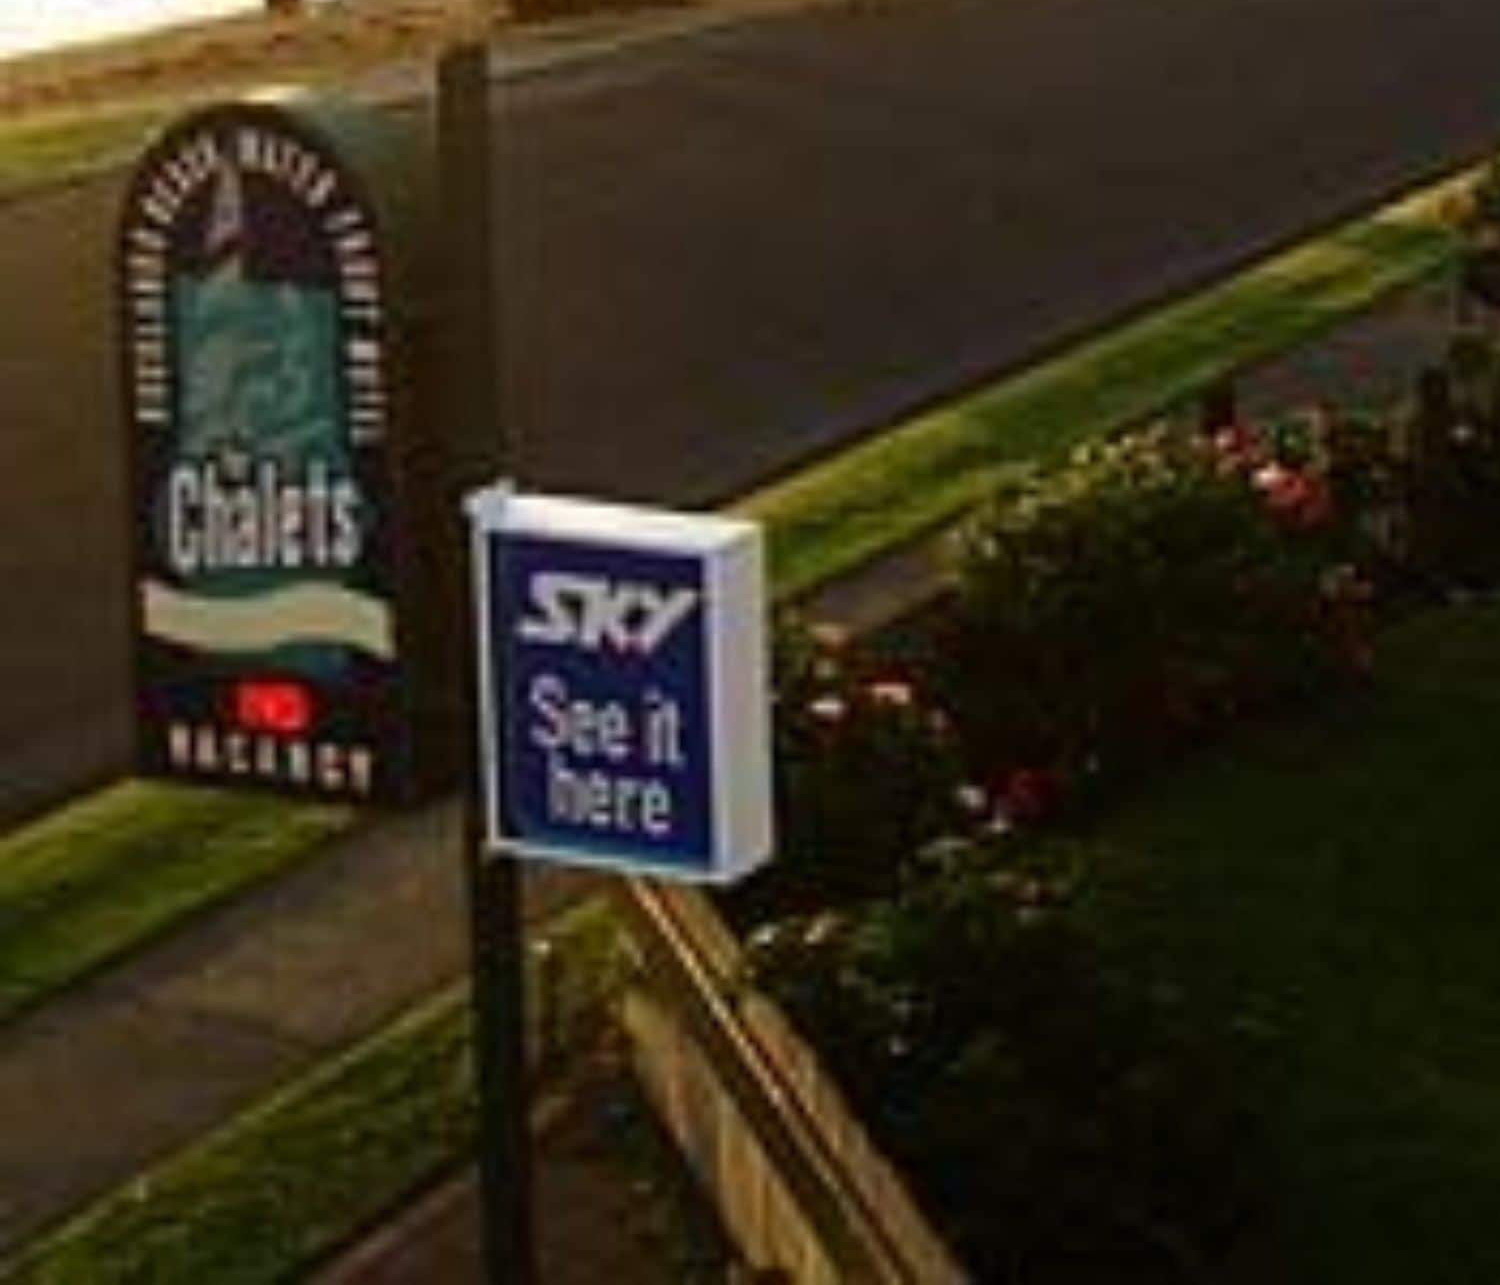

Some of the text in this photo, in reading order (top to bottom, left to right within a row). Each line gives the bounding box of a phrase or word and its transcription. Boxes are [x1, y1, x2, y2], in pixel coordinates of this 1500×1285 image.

[168, 459, 364, 574] Chalets
[516, 569, 701, 656] SKY
[529, 674, 689, 769] See it
[547, 750, 672, 836] here
